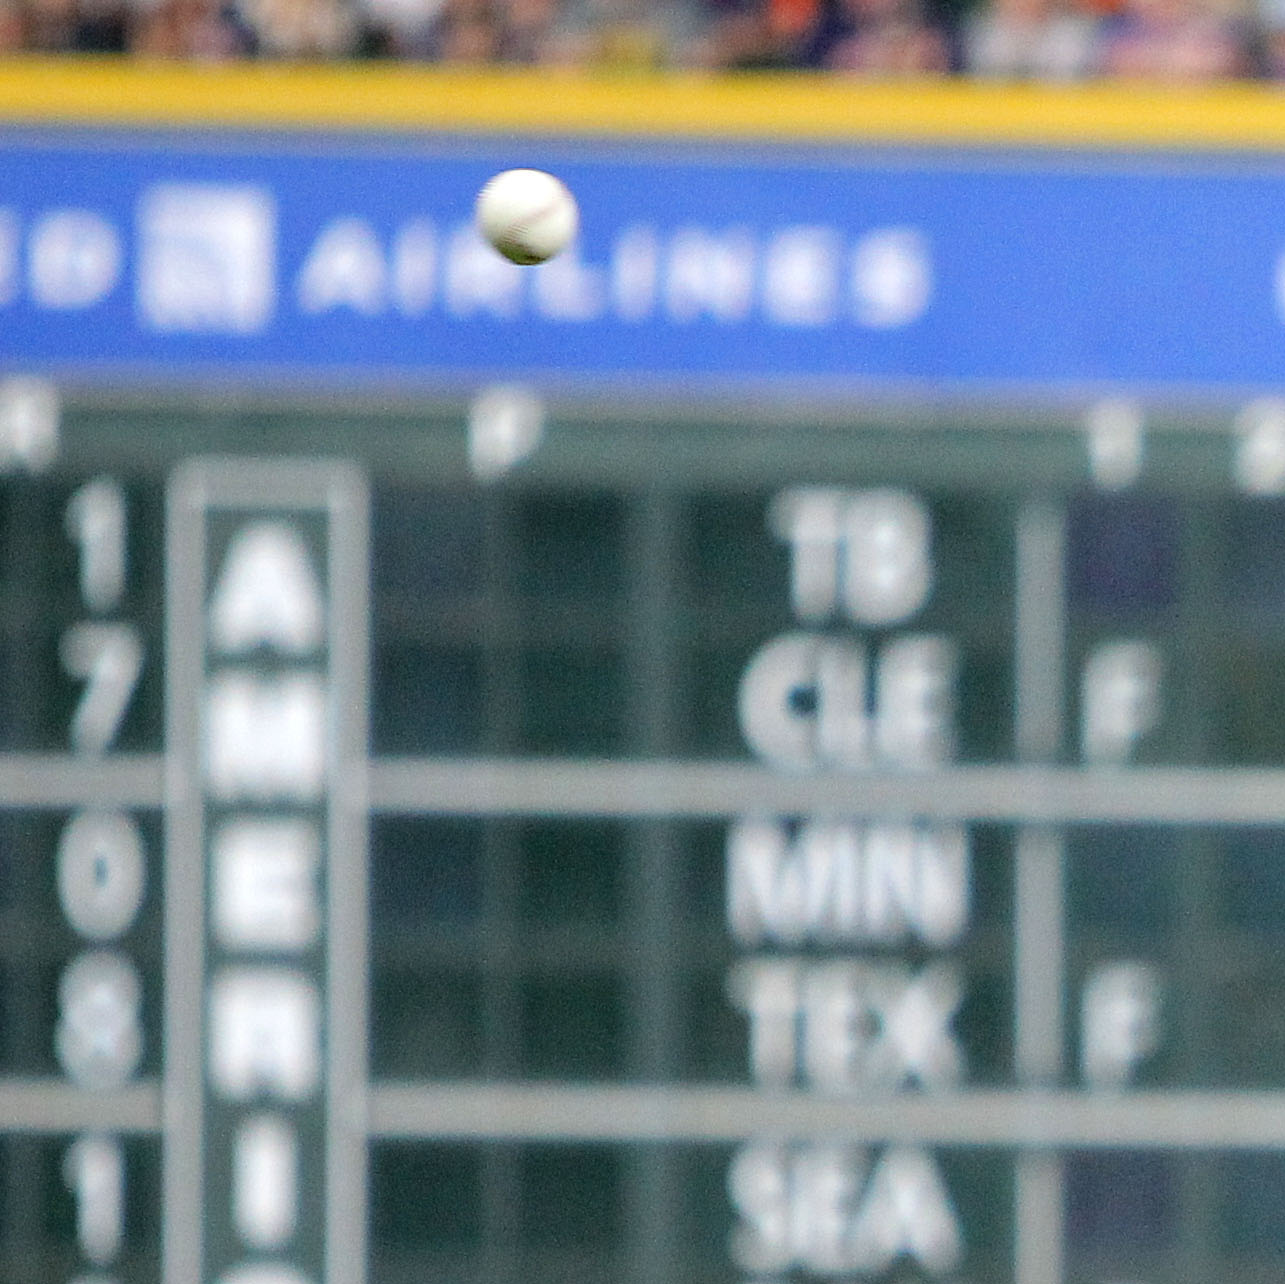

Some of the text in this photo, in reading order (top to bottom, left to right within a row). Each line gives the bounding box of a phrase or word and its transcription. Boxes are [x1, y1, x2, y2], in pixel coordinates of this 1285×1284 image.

[298, 217, 933, 328] AIRLINES
[66, 475, 127, 608] 1
[770, 487, 932, 626] TB
[58, 617, 144, 757] 7
[738, 632, 955, 770] CLE
[57, 805, 146, 942] 0
[727, 815, 970, 947] MIN
[55, 950, 143, 1090] 8
[725, 952, 966, 1092] TEX
[63, 1130, 125, 1267] 1
[727, 1138, 963, 1275] SEA
